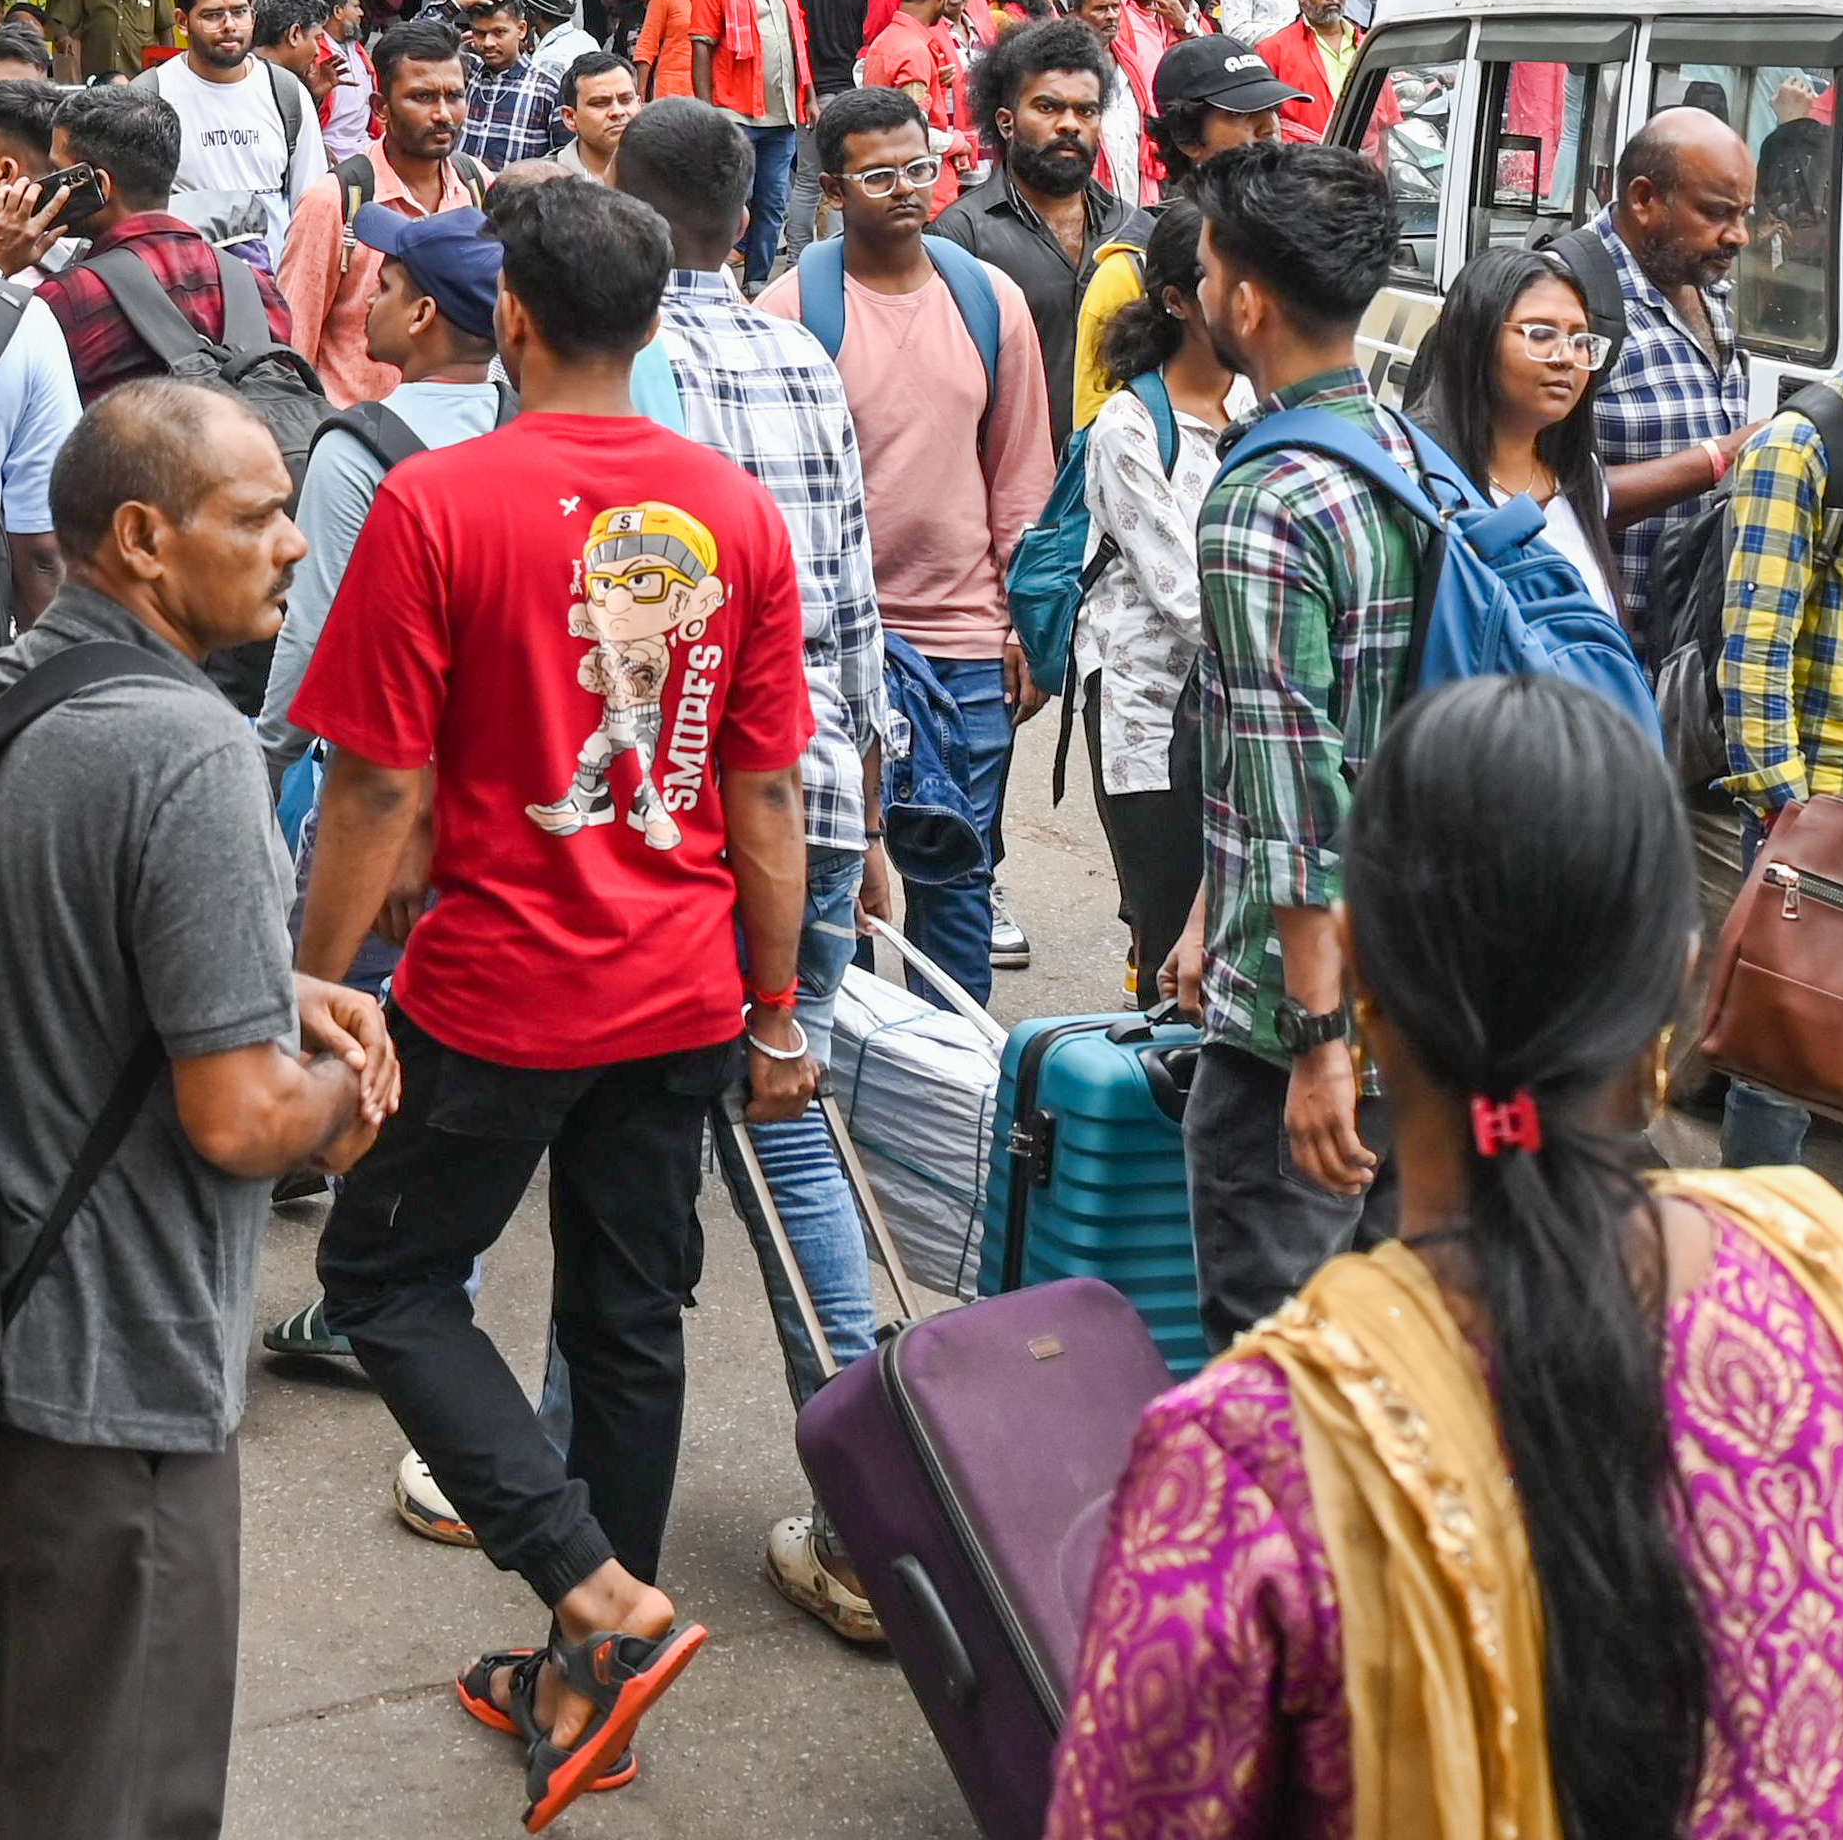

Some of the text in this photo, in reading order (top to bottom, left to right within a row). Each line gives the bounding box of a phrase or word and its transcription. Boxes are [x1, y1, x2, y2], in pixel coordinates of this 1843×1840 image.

[201, 129, 259, 147] UNTD YOUTH
[621, 515, 632, 529] S
[663, 644, 724, 812] SMURFS
